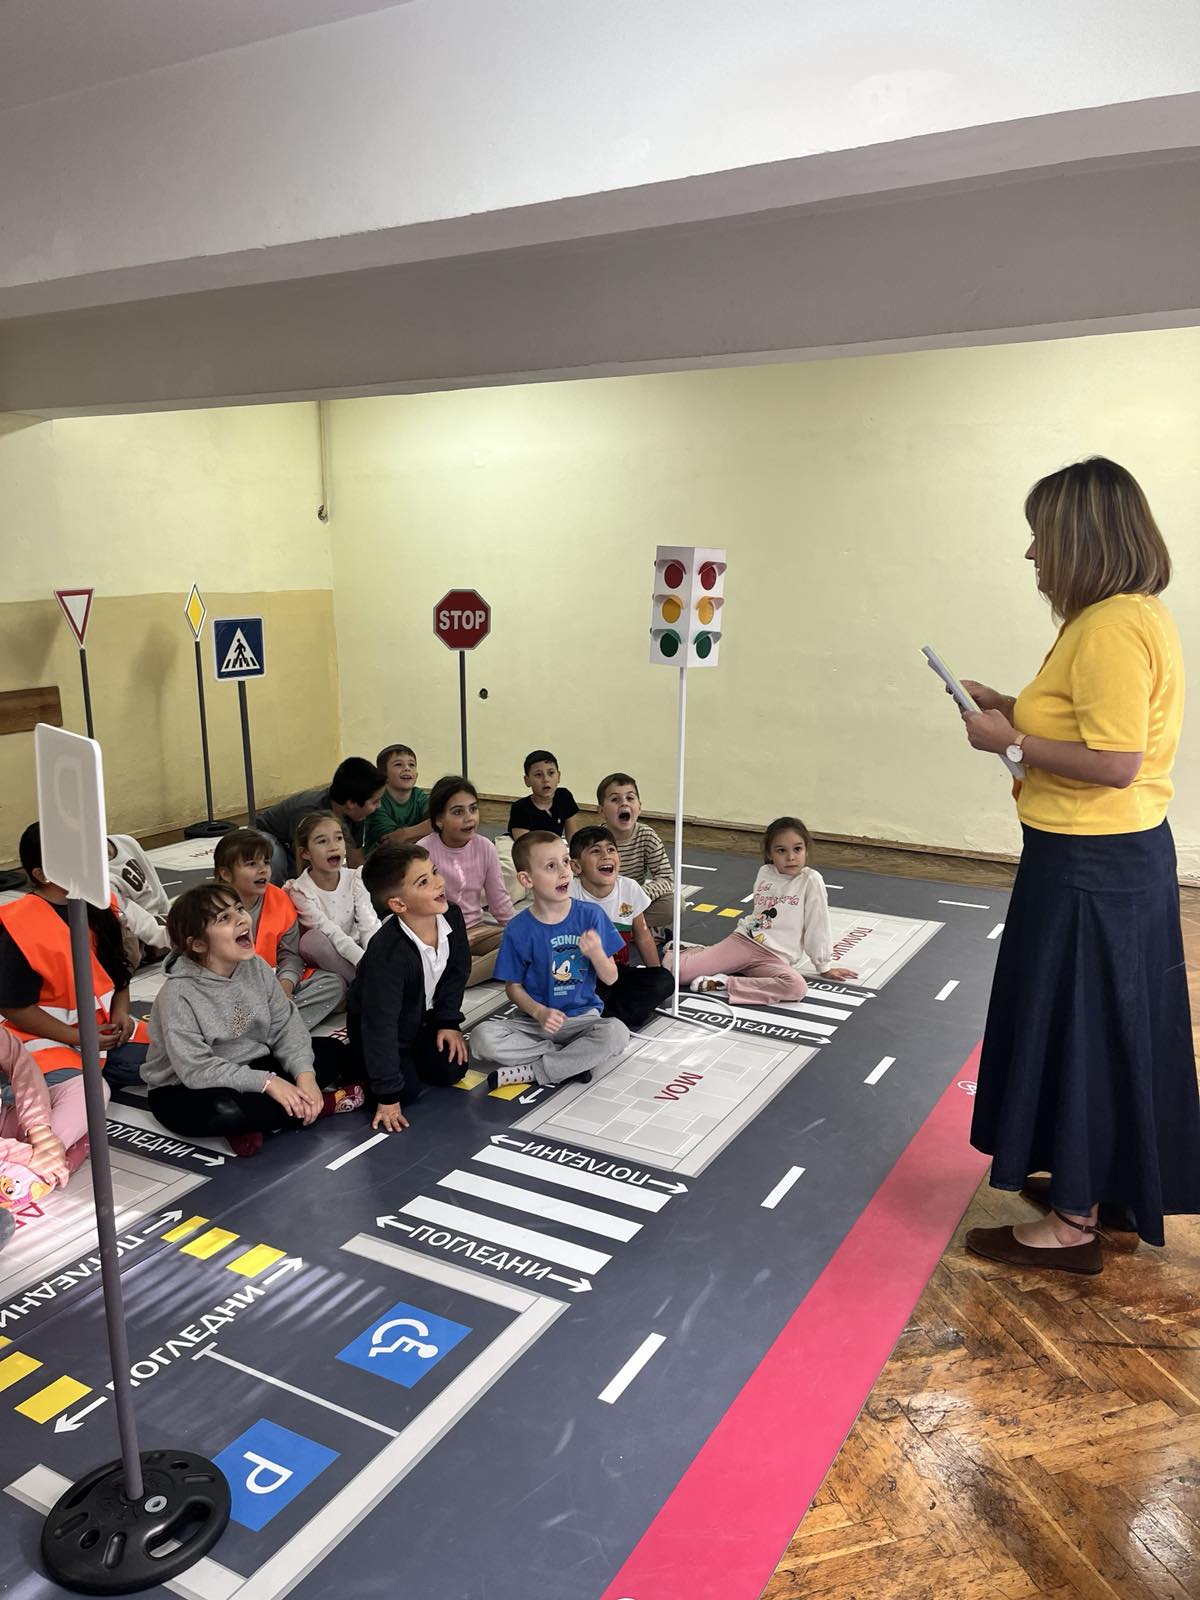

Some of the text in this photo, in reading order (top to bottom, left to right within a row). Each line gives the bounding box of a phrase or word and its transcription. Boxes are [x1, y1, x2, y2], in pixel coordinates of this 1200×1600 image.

[439, 610, 486, 630] STOP
[693, 1012, 800, 1039] ПОГЛЕДНИ
[654, 1071, 704, 1101] МОЛ
[106, 1121, 196, 1158] ОГЛЕДНИ
[521, 1141, 651, 1186] ПОГЛЕДНИ
[408, 1225, 552, 1281] ПОГЛЕДНИ
[0, 1234, 145, 1329] ПГЛЕДНИ
[243, 1450, 294, 1495] P
